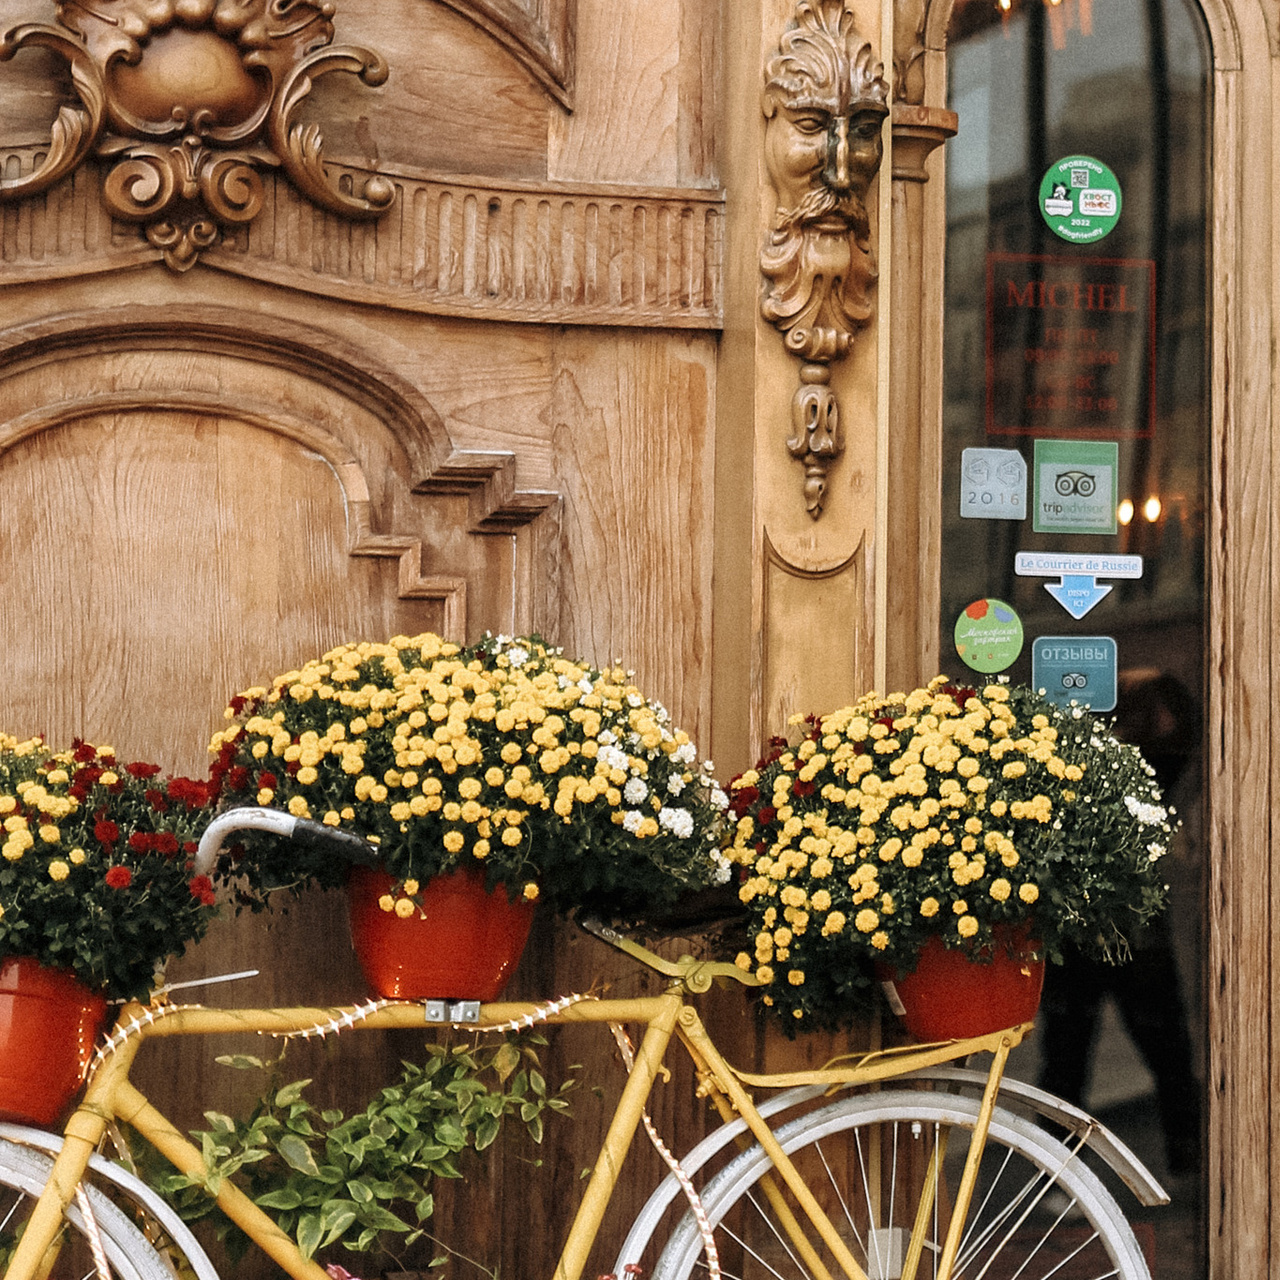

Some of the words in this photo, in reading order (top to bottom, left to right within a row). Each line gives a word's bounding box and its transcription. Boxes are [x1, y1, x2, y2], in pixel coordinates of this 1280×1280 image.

[1058, 160, 1103, 174] ПРОВЕРЕНО
[1006, 280, 1137, 312] MICHEL
[968, 491, 1020, 506] 2016
[1021, 558, 1034, 568] Le
[1036, 558, 1084, 570] Courrier
[1085, 560, 1099, 570] de
[1101, 561, 1138, 571] Russie
[1067, 589, 1090, 597] DISPO
[1041, 648, 1108, 660] ОТЗЫВЫ
